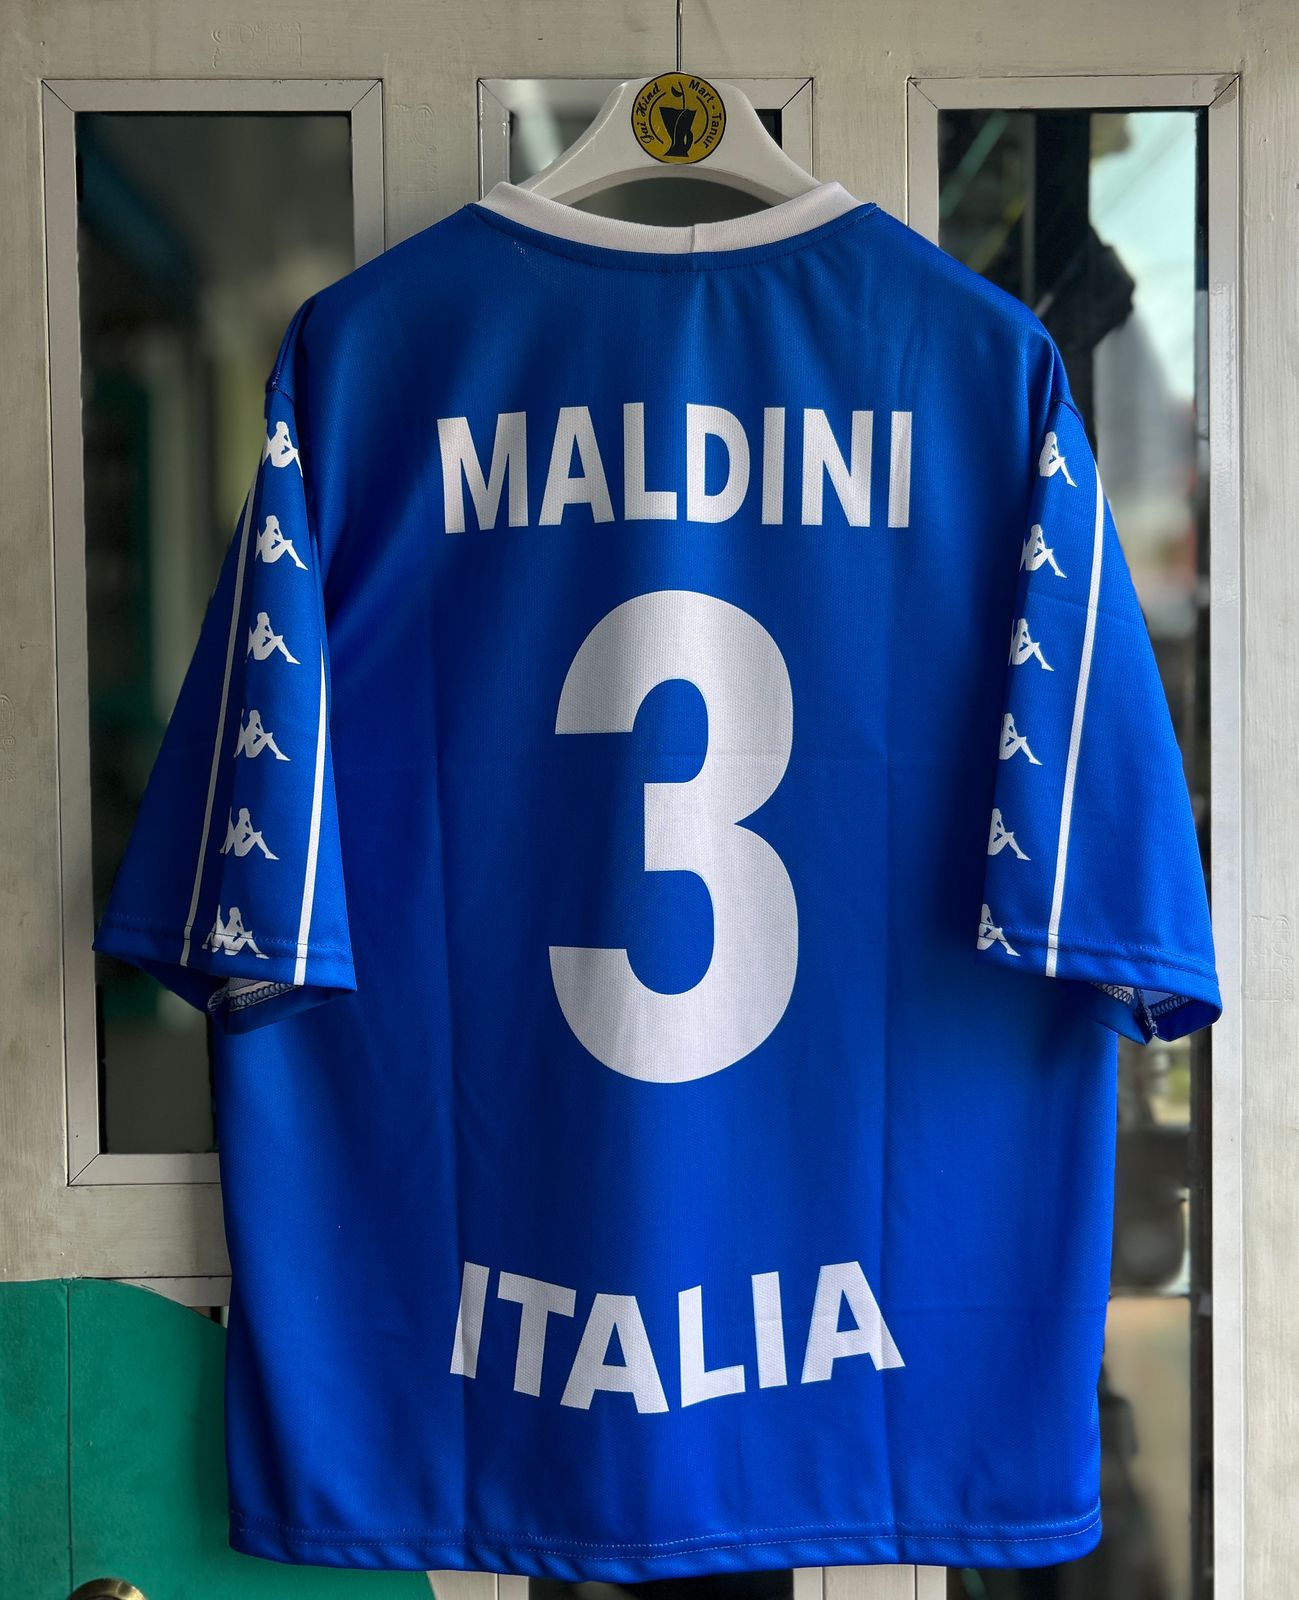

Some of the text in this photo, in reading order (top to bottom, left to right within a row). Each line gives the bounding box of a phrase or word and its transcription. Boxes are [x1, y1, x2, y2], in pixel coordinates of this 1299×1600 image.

[636, 82, 662, 118] Hind
[688, 79, 715, 104] Mart
[702, 113, 722, 149] Tanur
[436, 402, 913, 534] MALDINI
[549, 589, 799, 1084] 3
[449, 1261, 906, 1414] ITALIA
